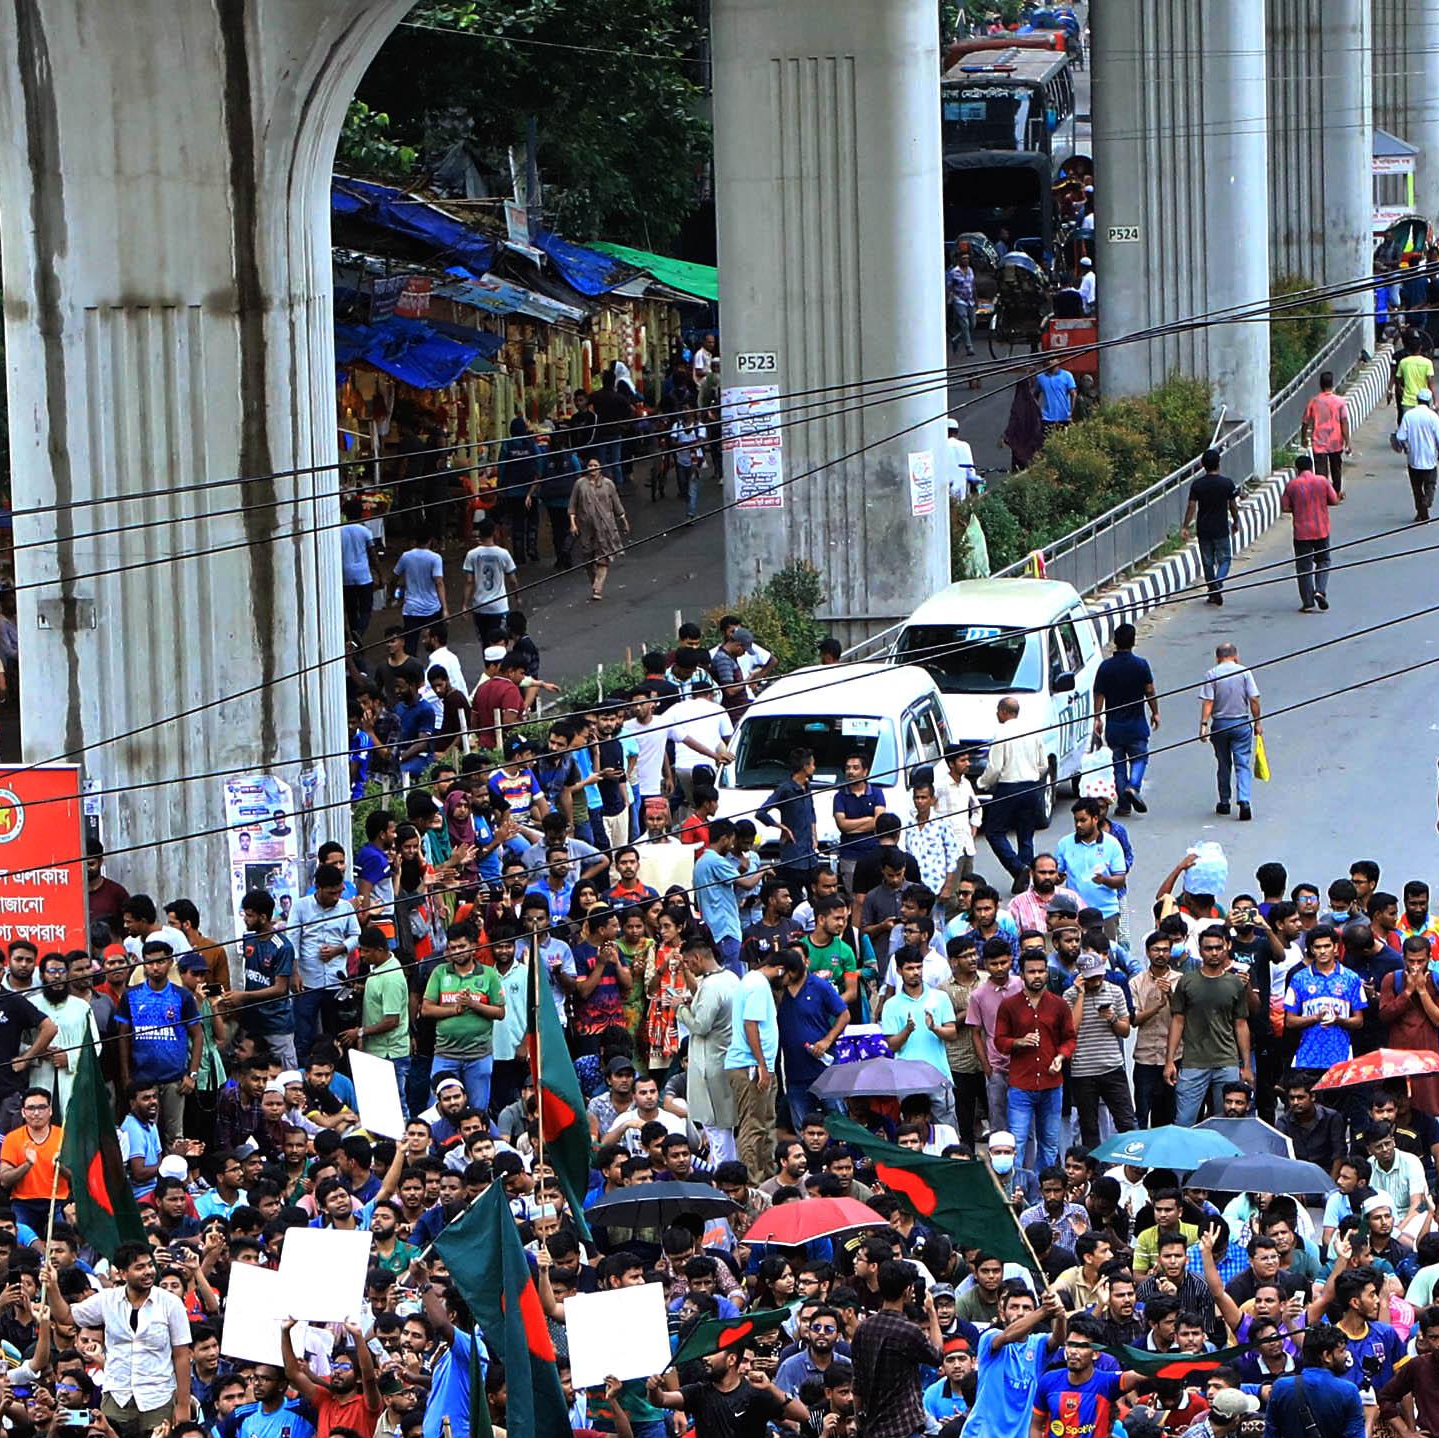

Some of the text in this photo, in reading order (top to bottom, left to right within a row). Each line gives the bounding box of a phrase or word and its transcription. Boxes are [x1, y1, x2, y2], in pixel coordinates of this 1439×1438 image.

[1109, 229, 1139, 240] P524
[738, 355, 775, 370] P523
[12, 867, 69, 885] এলাকায়
[16, 925, 66, 941] অপরাধ
[1066, 1423, 1096, 1438] Spotify
